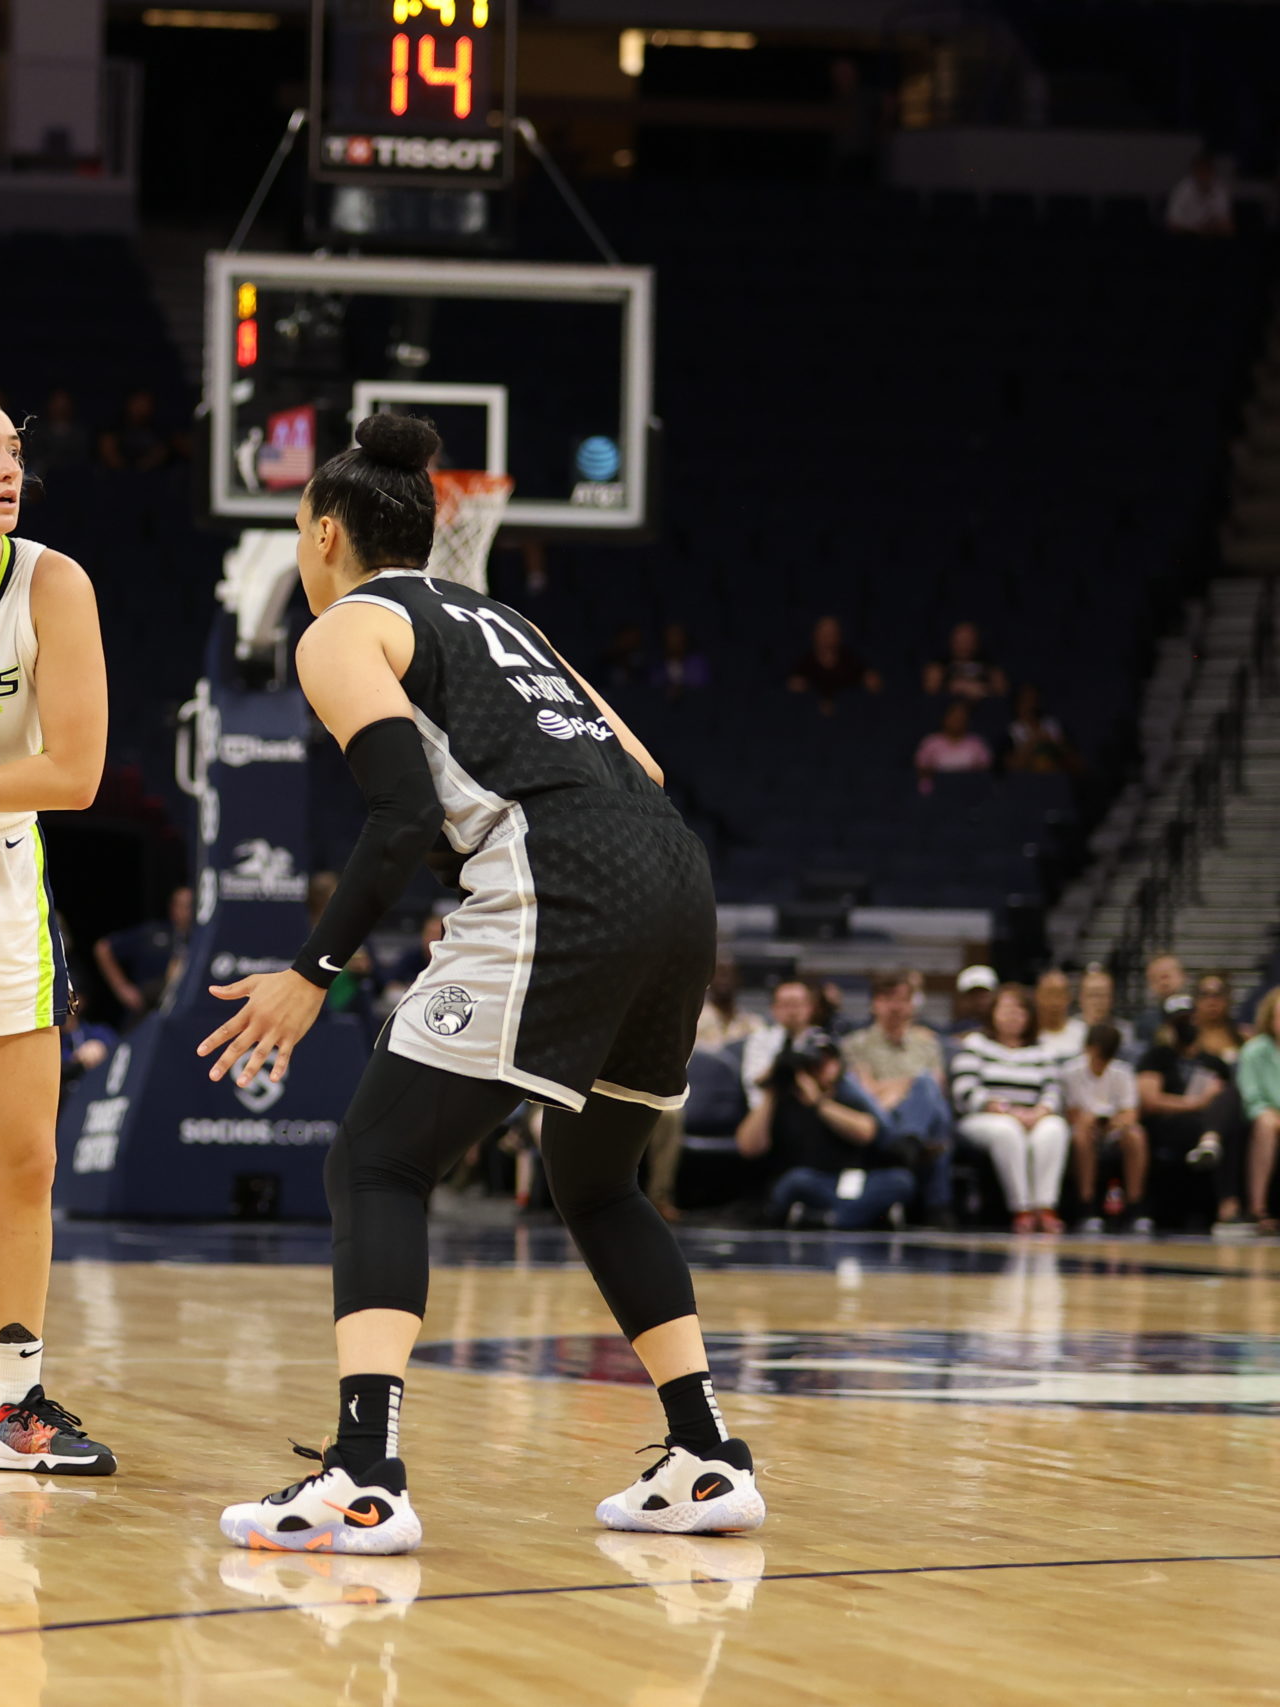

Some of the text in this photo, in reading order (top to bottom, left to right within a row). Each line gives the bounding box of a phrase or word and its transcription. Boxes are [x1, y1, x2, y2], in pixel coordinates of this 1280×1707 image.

[391, 33, 473, 119] 14
[373, 137, 500, 171] TISSOT
[441, 602, 557, 669] 21
